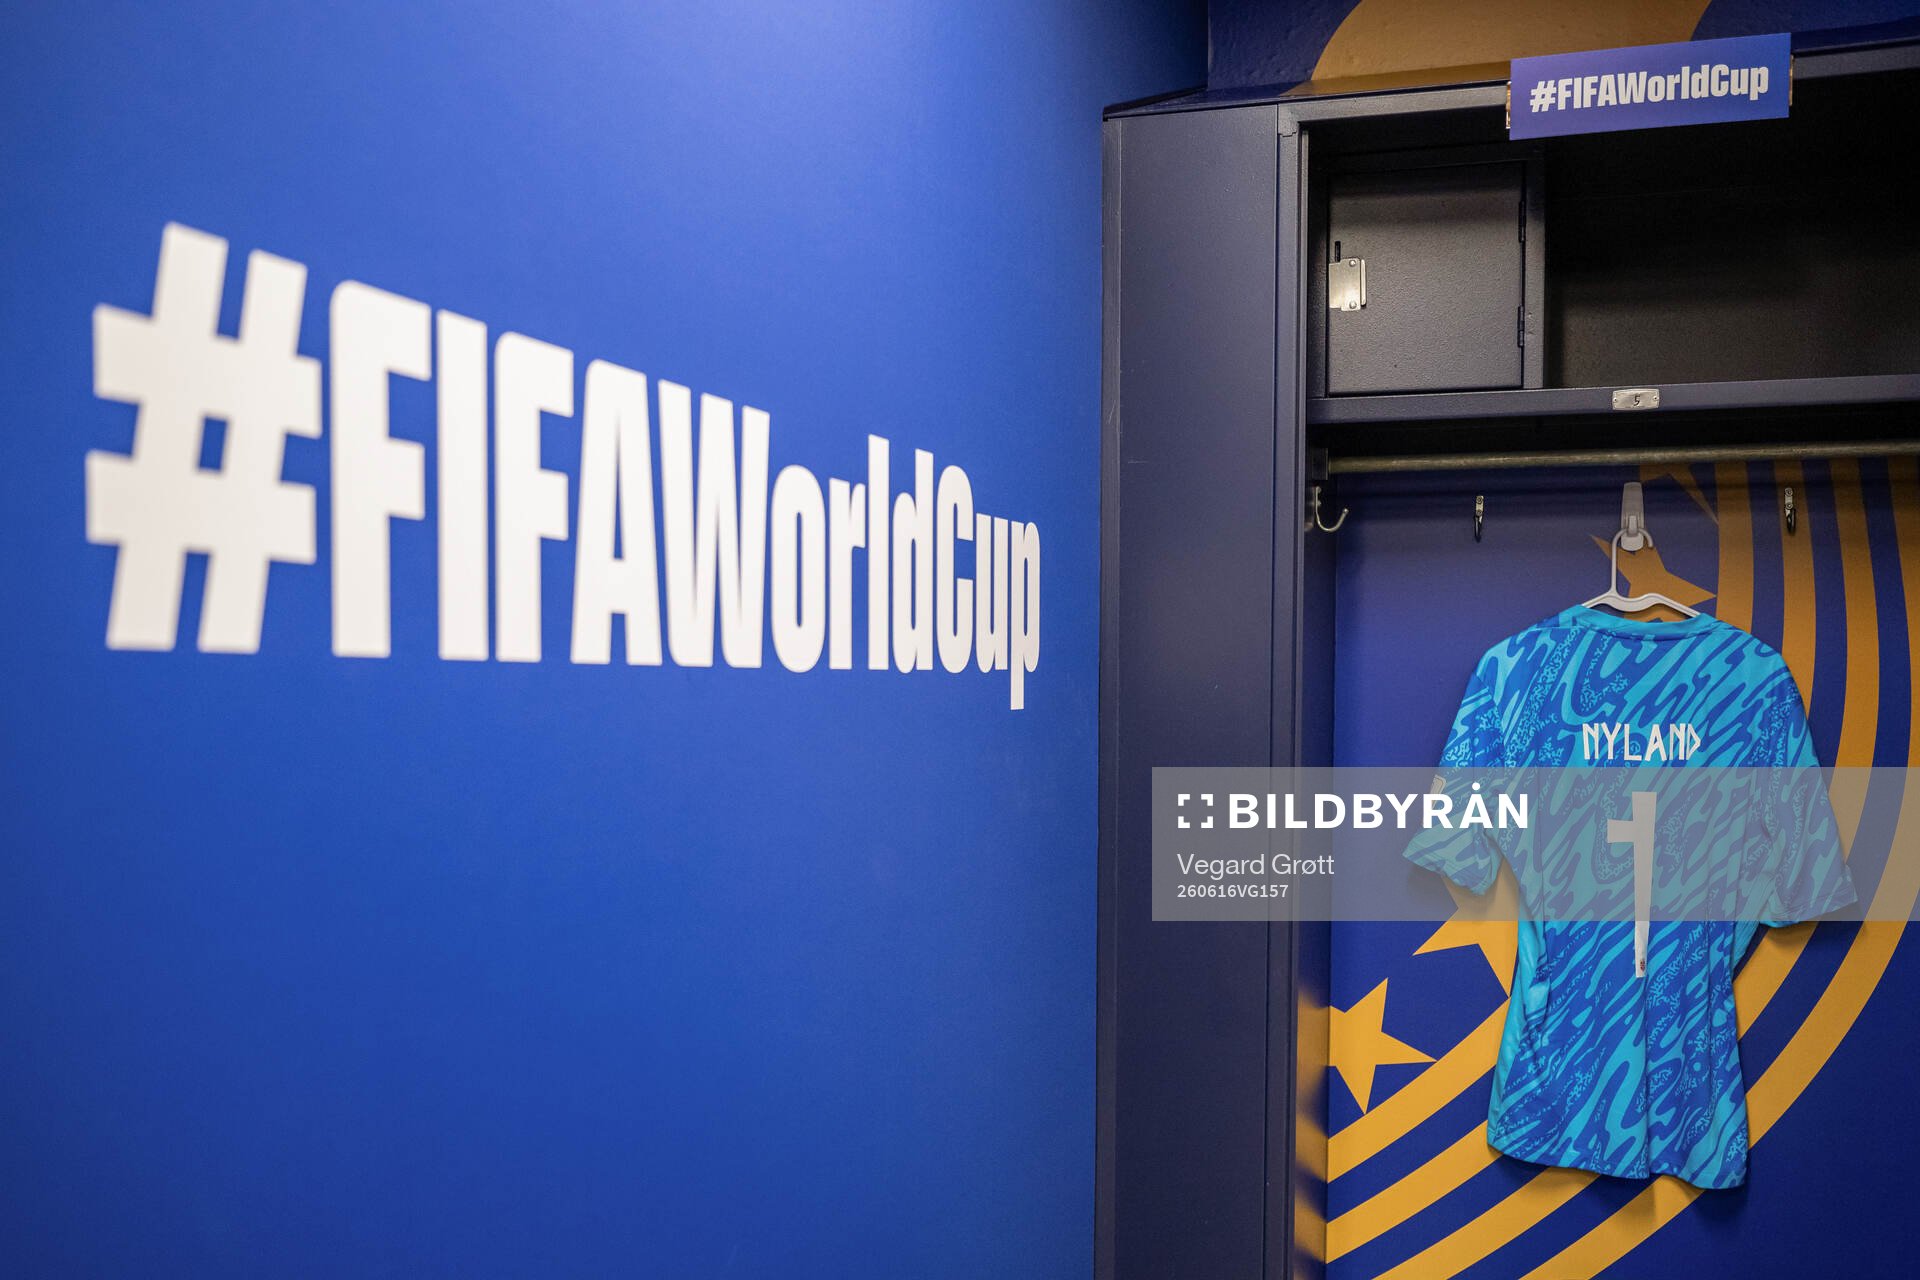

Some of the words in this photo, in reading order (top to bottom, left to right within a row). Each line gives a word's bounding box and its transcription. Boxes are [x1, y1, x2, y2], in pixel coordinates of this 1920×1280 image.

[1530, 64, 1769, 113] #FIFAWorldCup
[1633, 394, 1641, 407] 5
[85, 221, 1041, 711] #FIFAWorldCup
[1582, 722, 1701, 761] NYLAND
[1607, 791, 1657, 978] 1
